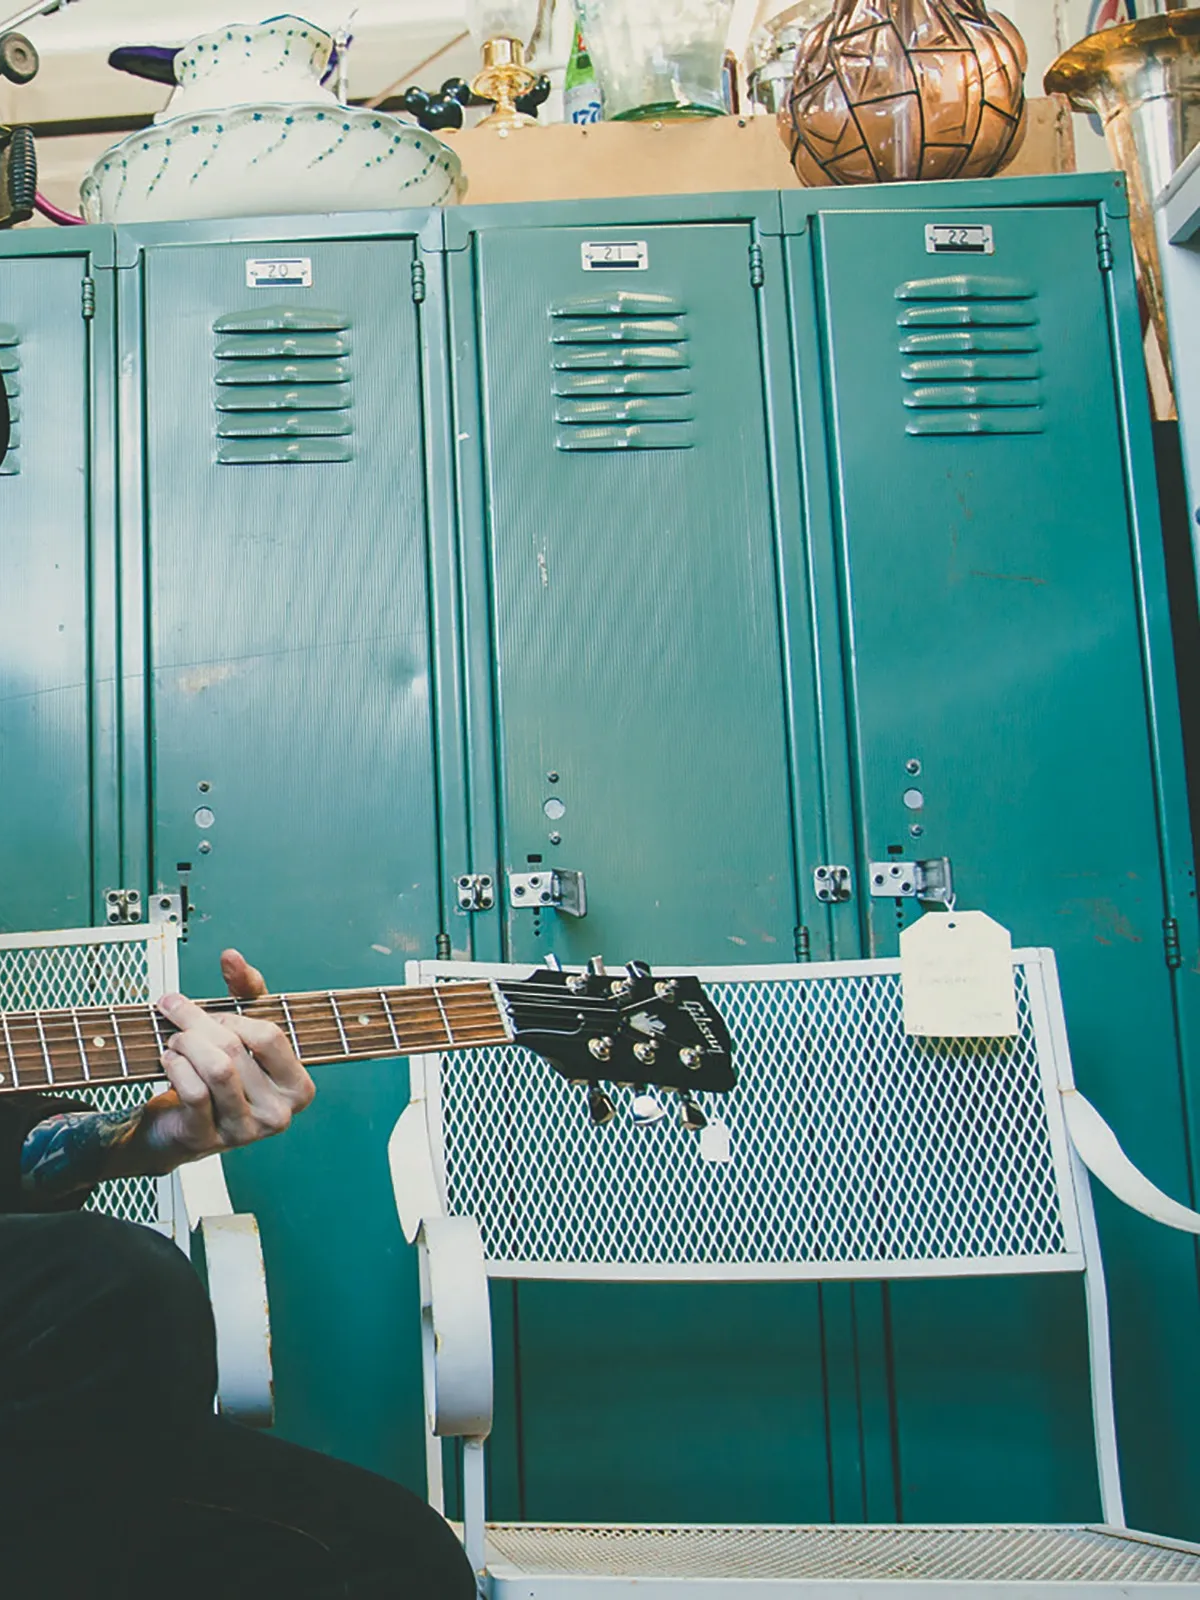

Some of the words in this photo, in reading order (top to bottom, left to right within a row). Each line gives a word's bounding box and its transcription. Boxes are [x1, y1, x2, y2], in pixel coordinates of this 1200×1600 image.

[948, 229, 969, 246] 22
[604, 246, 623, 260] 21
[267, 263, 289, 279] 20
[678, 1000, 726, 1055] Gibson
